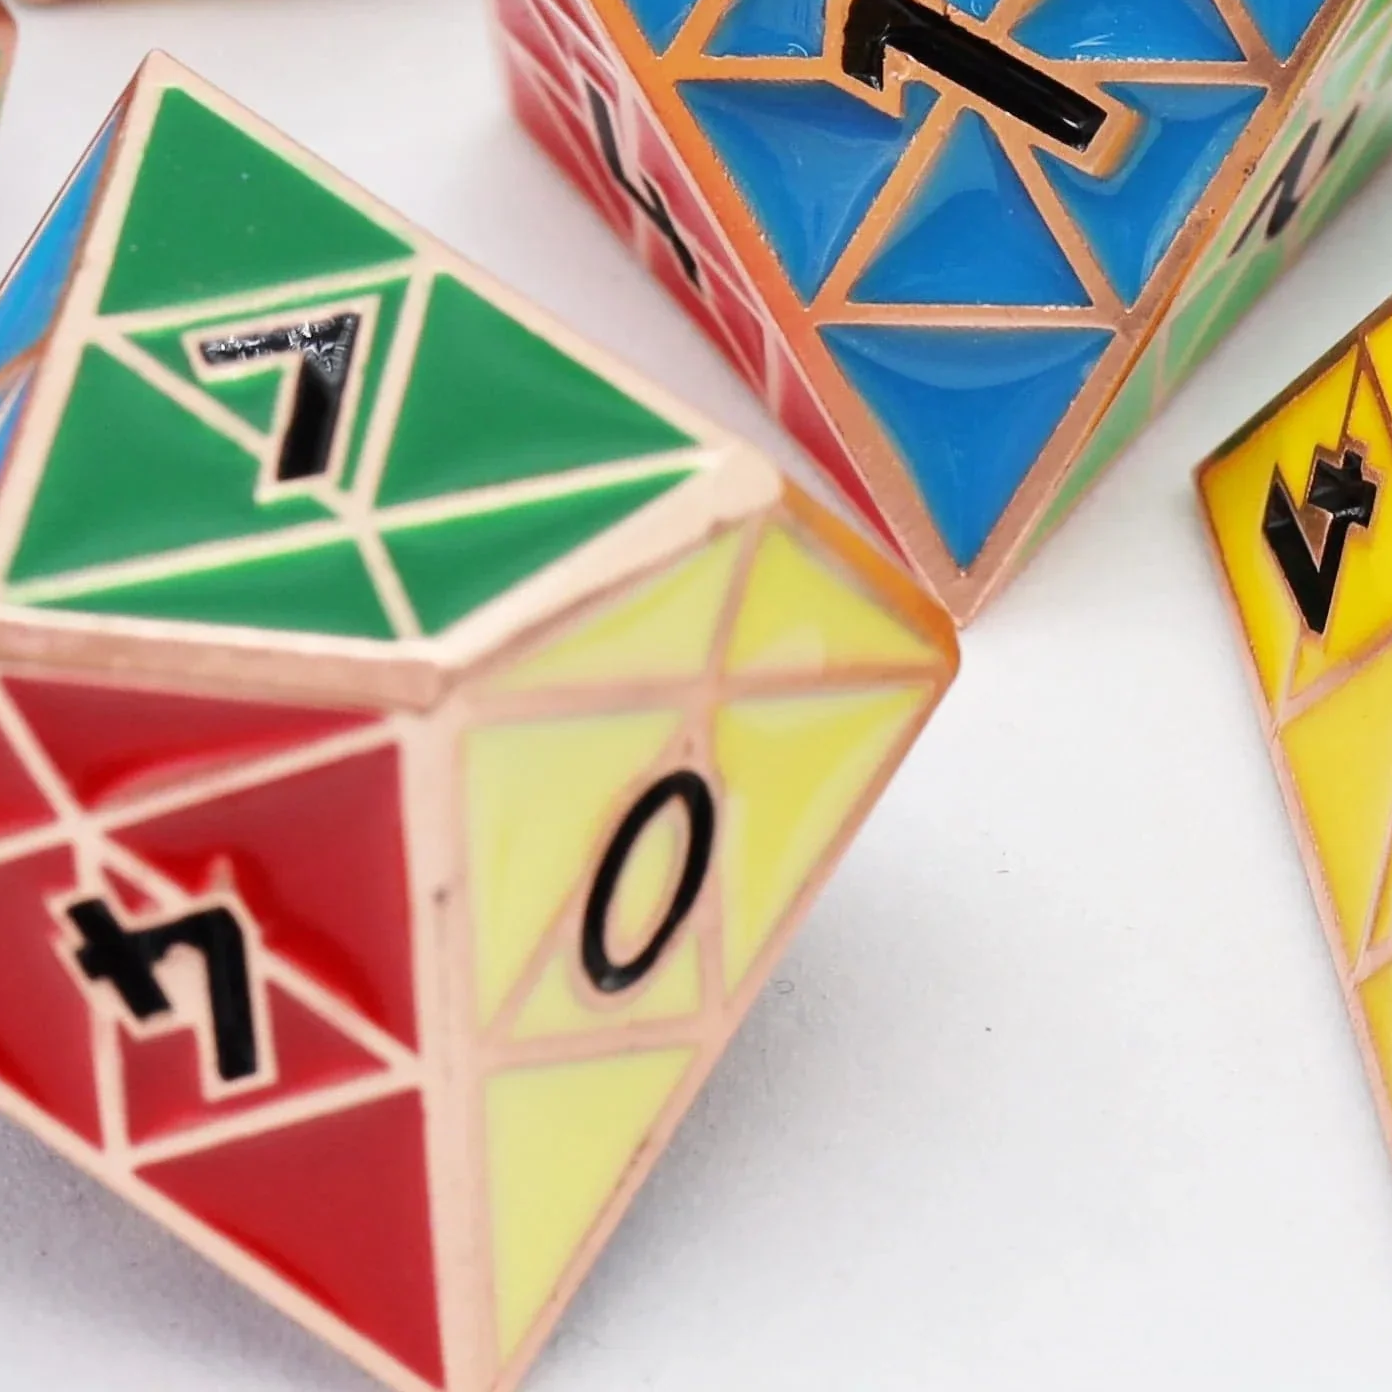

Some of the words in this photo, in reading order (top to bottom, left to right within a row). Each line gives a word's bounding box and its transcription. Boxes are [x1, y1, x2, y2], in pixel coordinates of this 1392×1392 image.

[200, 310, 363, 486] 7
[1261, 446, 1380, 638] 4
[579, 768, 717, 996] 0
[63, 895, 260, 1084] 4
